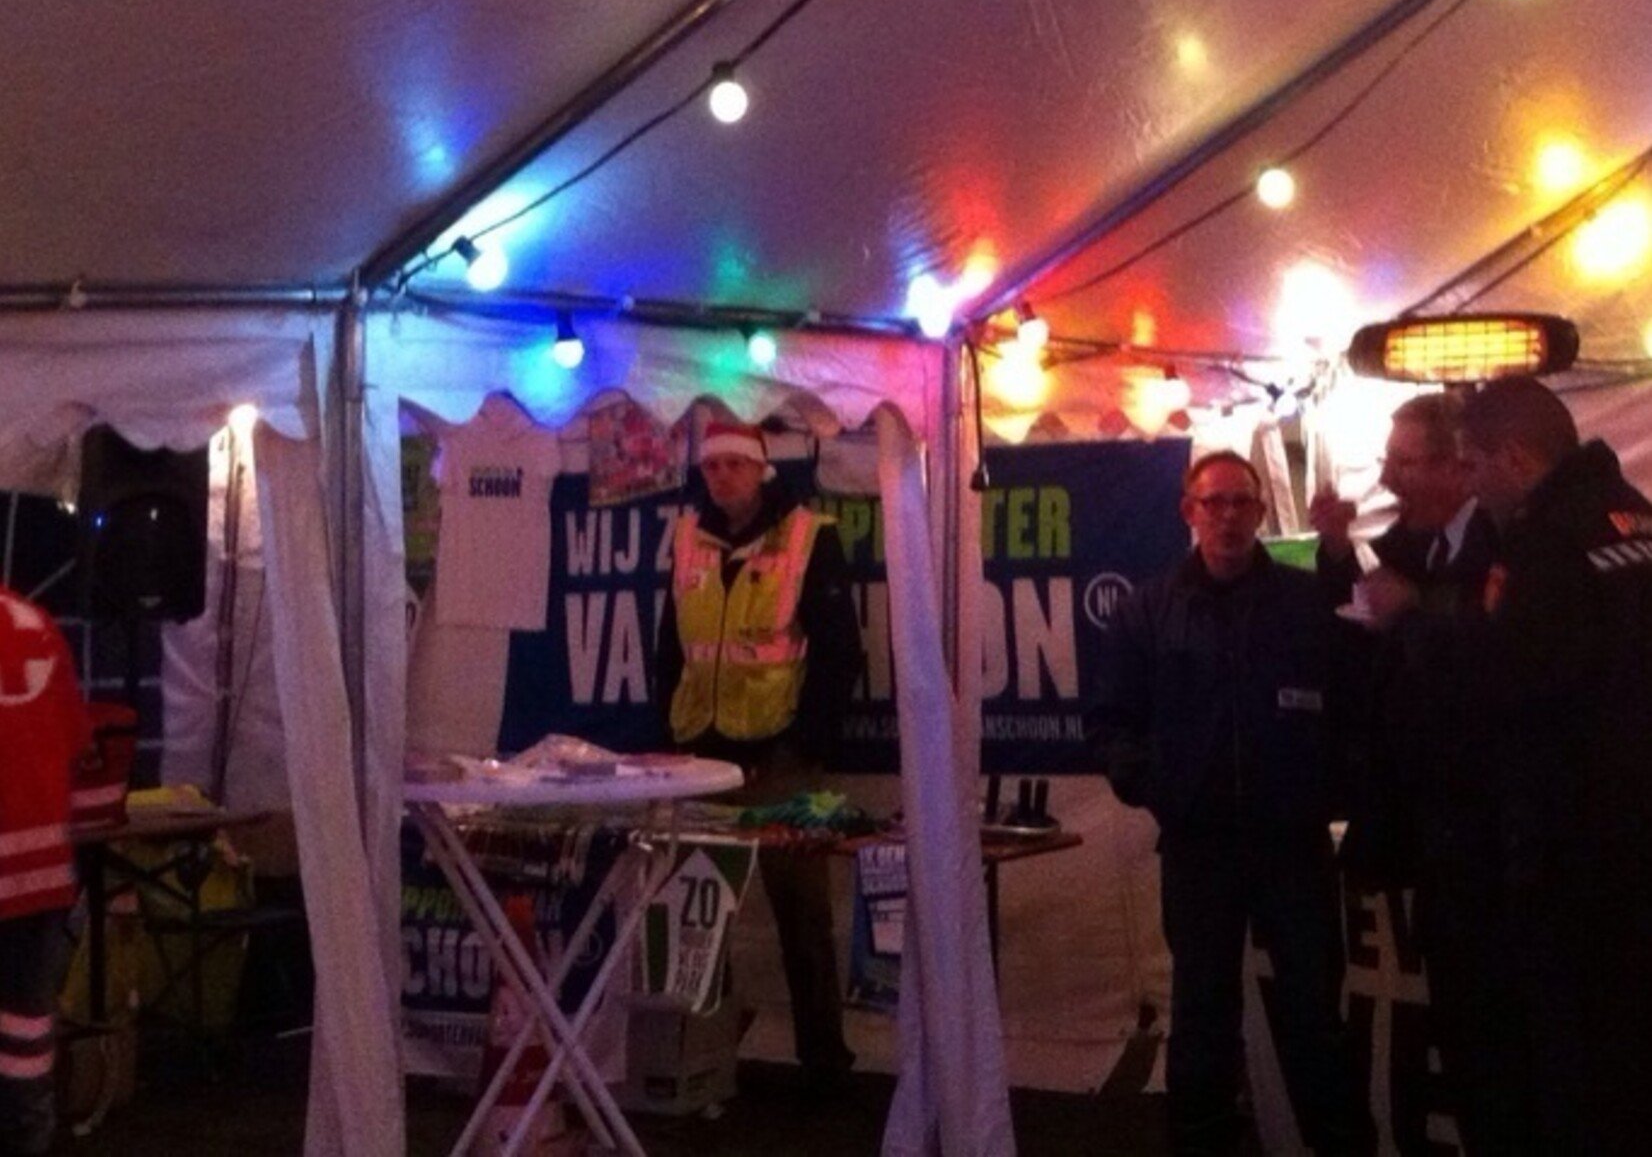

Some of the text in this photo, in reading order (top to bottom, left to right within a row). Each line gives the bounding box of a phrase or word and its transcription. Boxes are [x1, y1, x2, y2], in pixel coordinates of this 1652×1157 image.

[566, 505, 642, 577] WIJ
[565, 589, 668, 704] VA
[401, 926, 493, 1000] CHO
